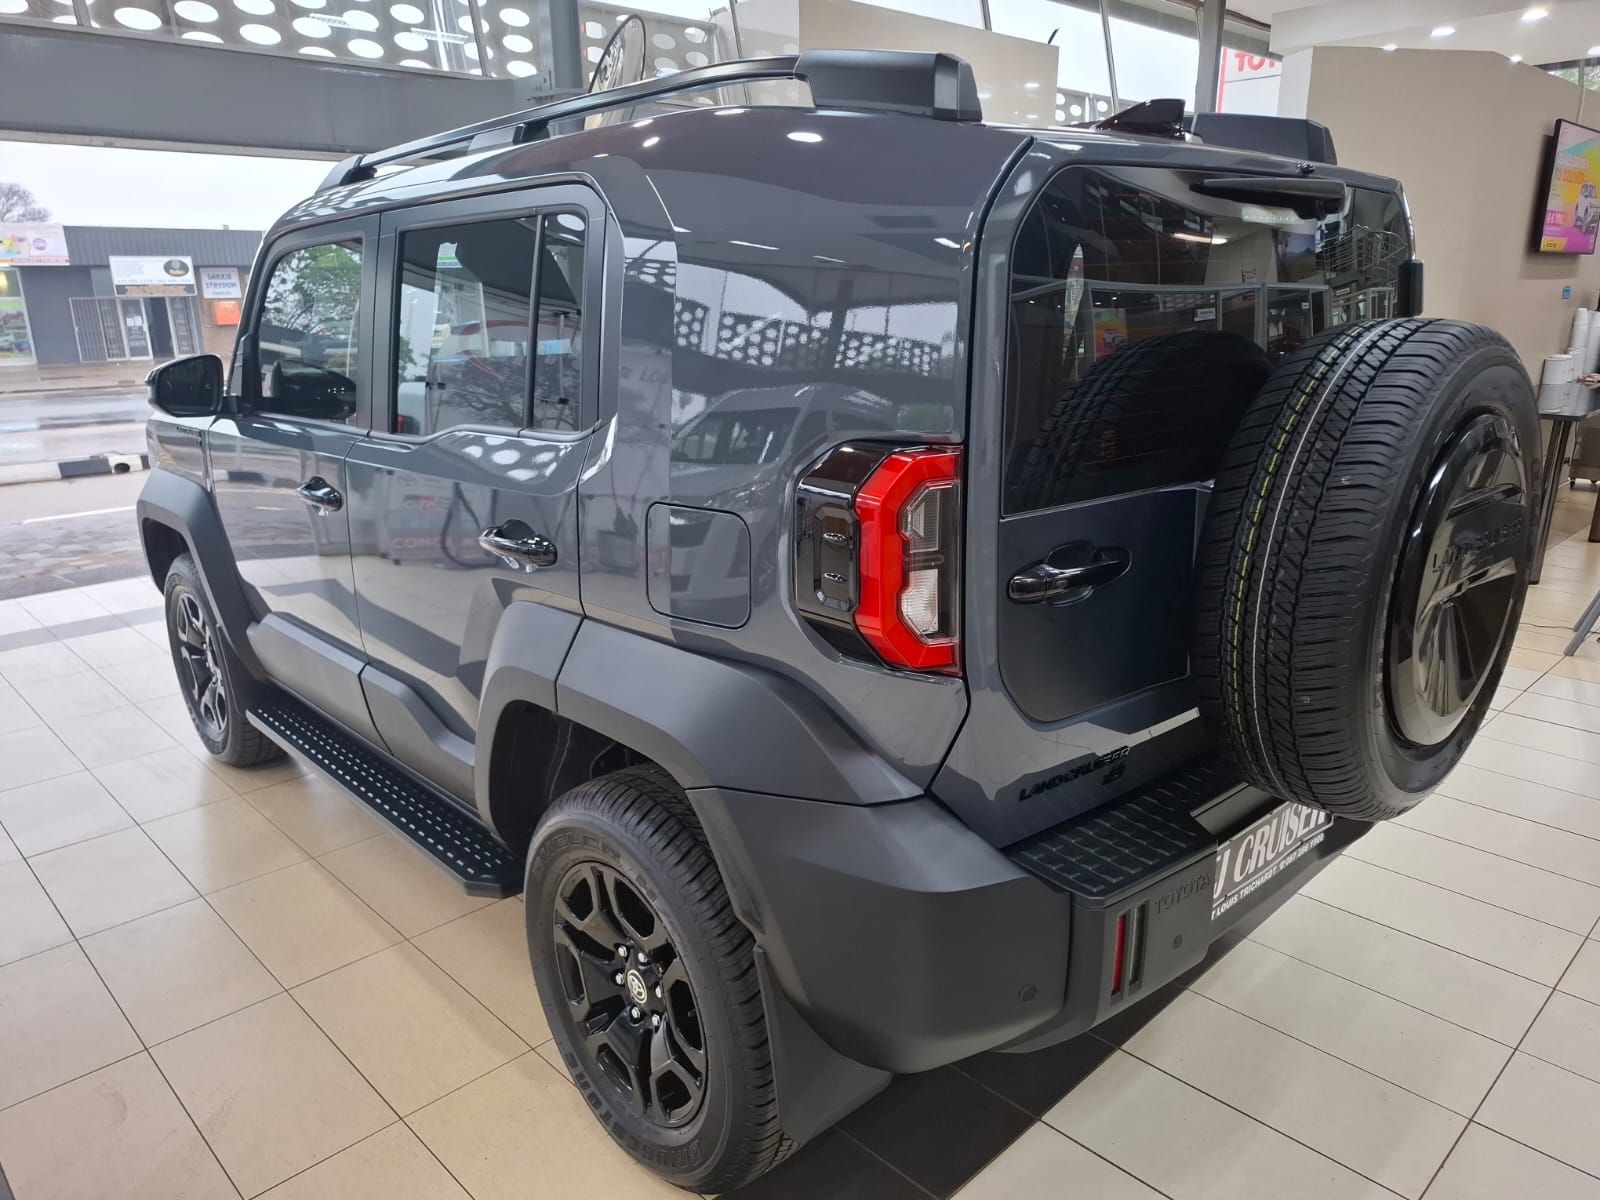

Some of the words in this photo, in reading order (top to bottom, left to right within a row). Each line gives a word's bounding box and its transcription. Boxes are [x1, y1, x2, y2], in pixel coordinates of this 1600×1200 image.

[1154, 872, 1211, 915] TOYOTA
[1213, 848, 1231, 899] J
[1216, 894, 1239, 917] LOUIS
